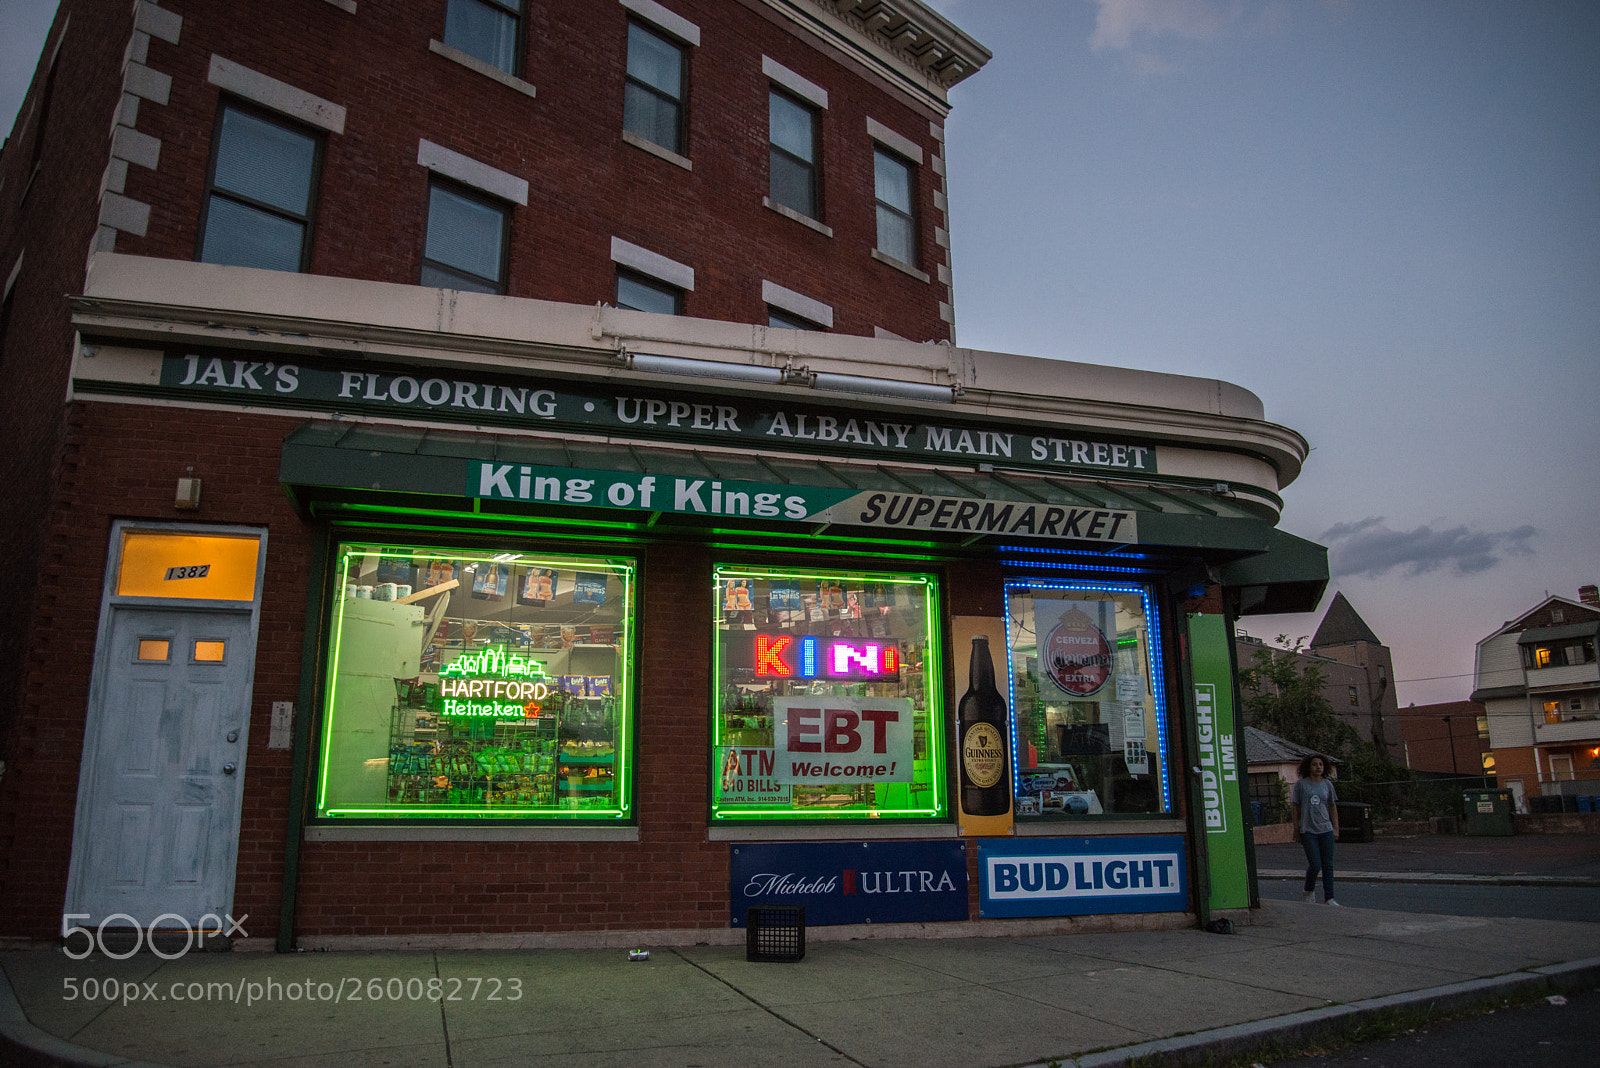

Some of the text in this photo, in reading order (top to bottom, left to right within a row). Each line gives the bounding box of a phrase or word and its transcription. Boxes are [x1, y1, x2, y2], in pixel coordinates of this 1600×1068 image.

[179, 354, 1148, 470] JAK'S FLOORING UPPER ALBANY MAIN STREET
[479, 462, 1128, 541] King of Kings SUPERMARKET
[168, 565, 209, 580] 1382
[1056, 636, 1099, 645] CERVEZA
[441, 680, 548, 701] HARTFORD
[1065, 674, 1096, 683] EXTRA
[442, 700, 526, 718] Heineken
[787, 707, 900, 754] EBT
[722, 749, 775, 777] ATM
[965, 746, 1002, 758] GUINNESS
[1195, 688, 1222, 827] BUD LIGHT
[1220, 734, 1237, 781] LIME
[791, 761, 897, 778] Welcome!
[747, 779, 782, 793] BILLS
[743, 869, 957, 899] Michelob ULTRA
[993, 859, 1174, 893] BUD LIGHT
